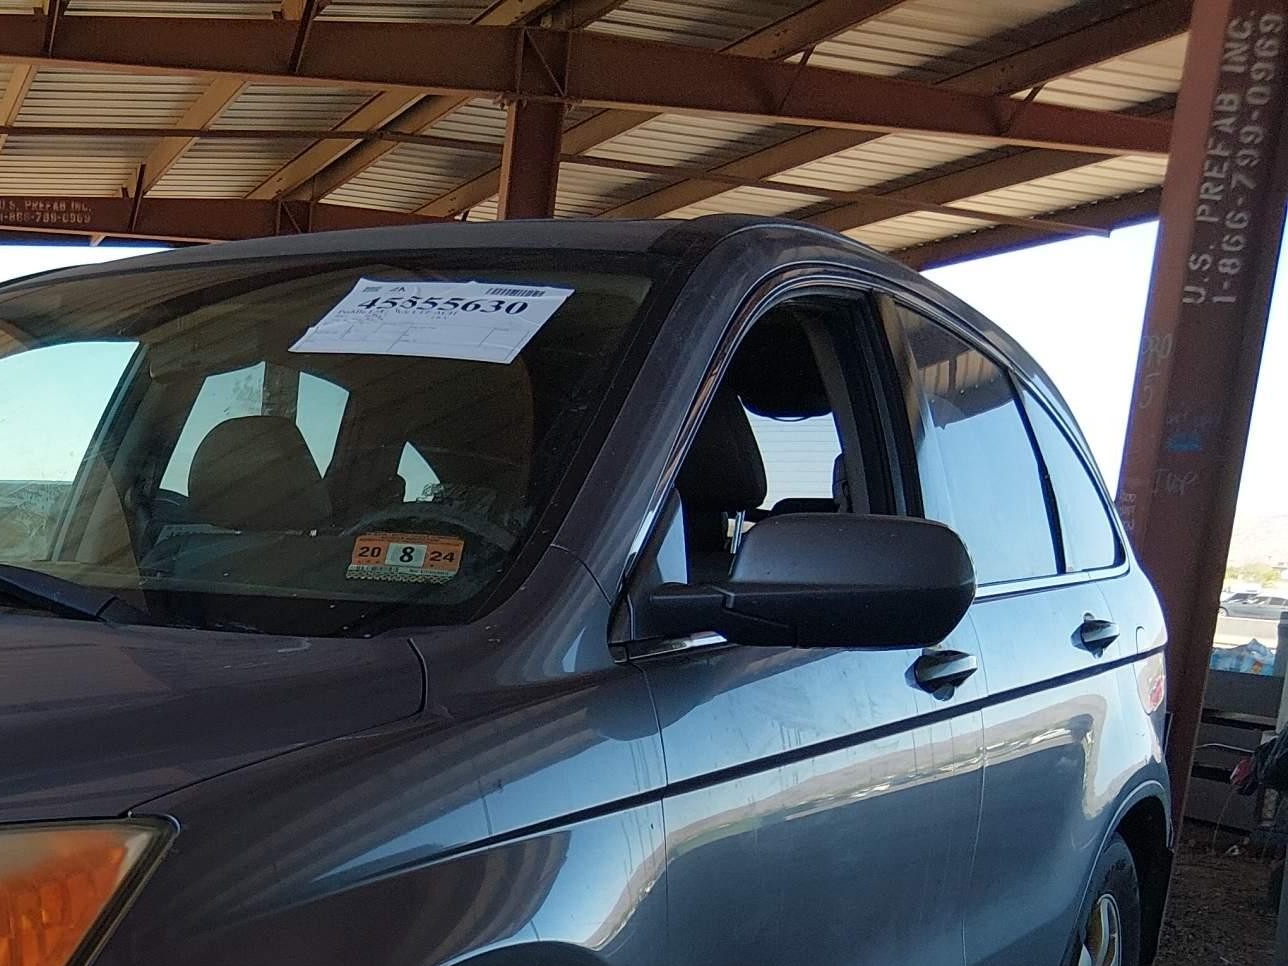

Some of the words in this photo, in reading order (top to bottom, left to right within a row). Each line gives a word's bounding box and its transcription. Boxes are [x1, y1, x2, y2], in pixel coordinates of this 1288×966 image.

[1222, 10, 1256, 74] INC.
[1196, 92, 1242, 223] PREFAB
[1212, 12, 1283, 304] 1-866-799-0969
[25, 200, 66, 212] PREFAB
[357, 295, 529, 315] 45555630
[1182, 243, 1217, 305] U.S.
[358, 546, 382, 558] 20
[399, 546, 415, 563] 8
[430, 551, 455, 563] 24
